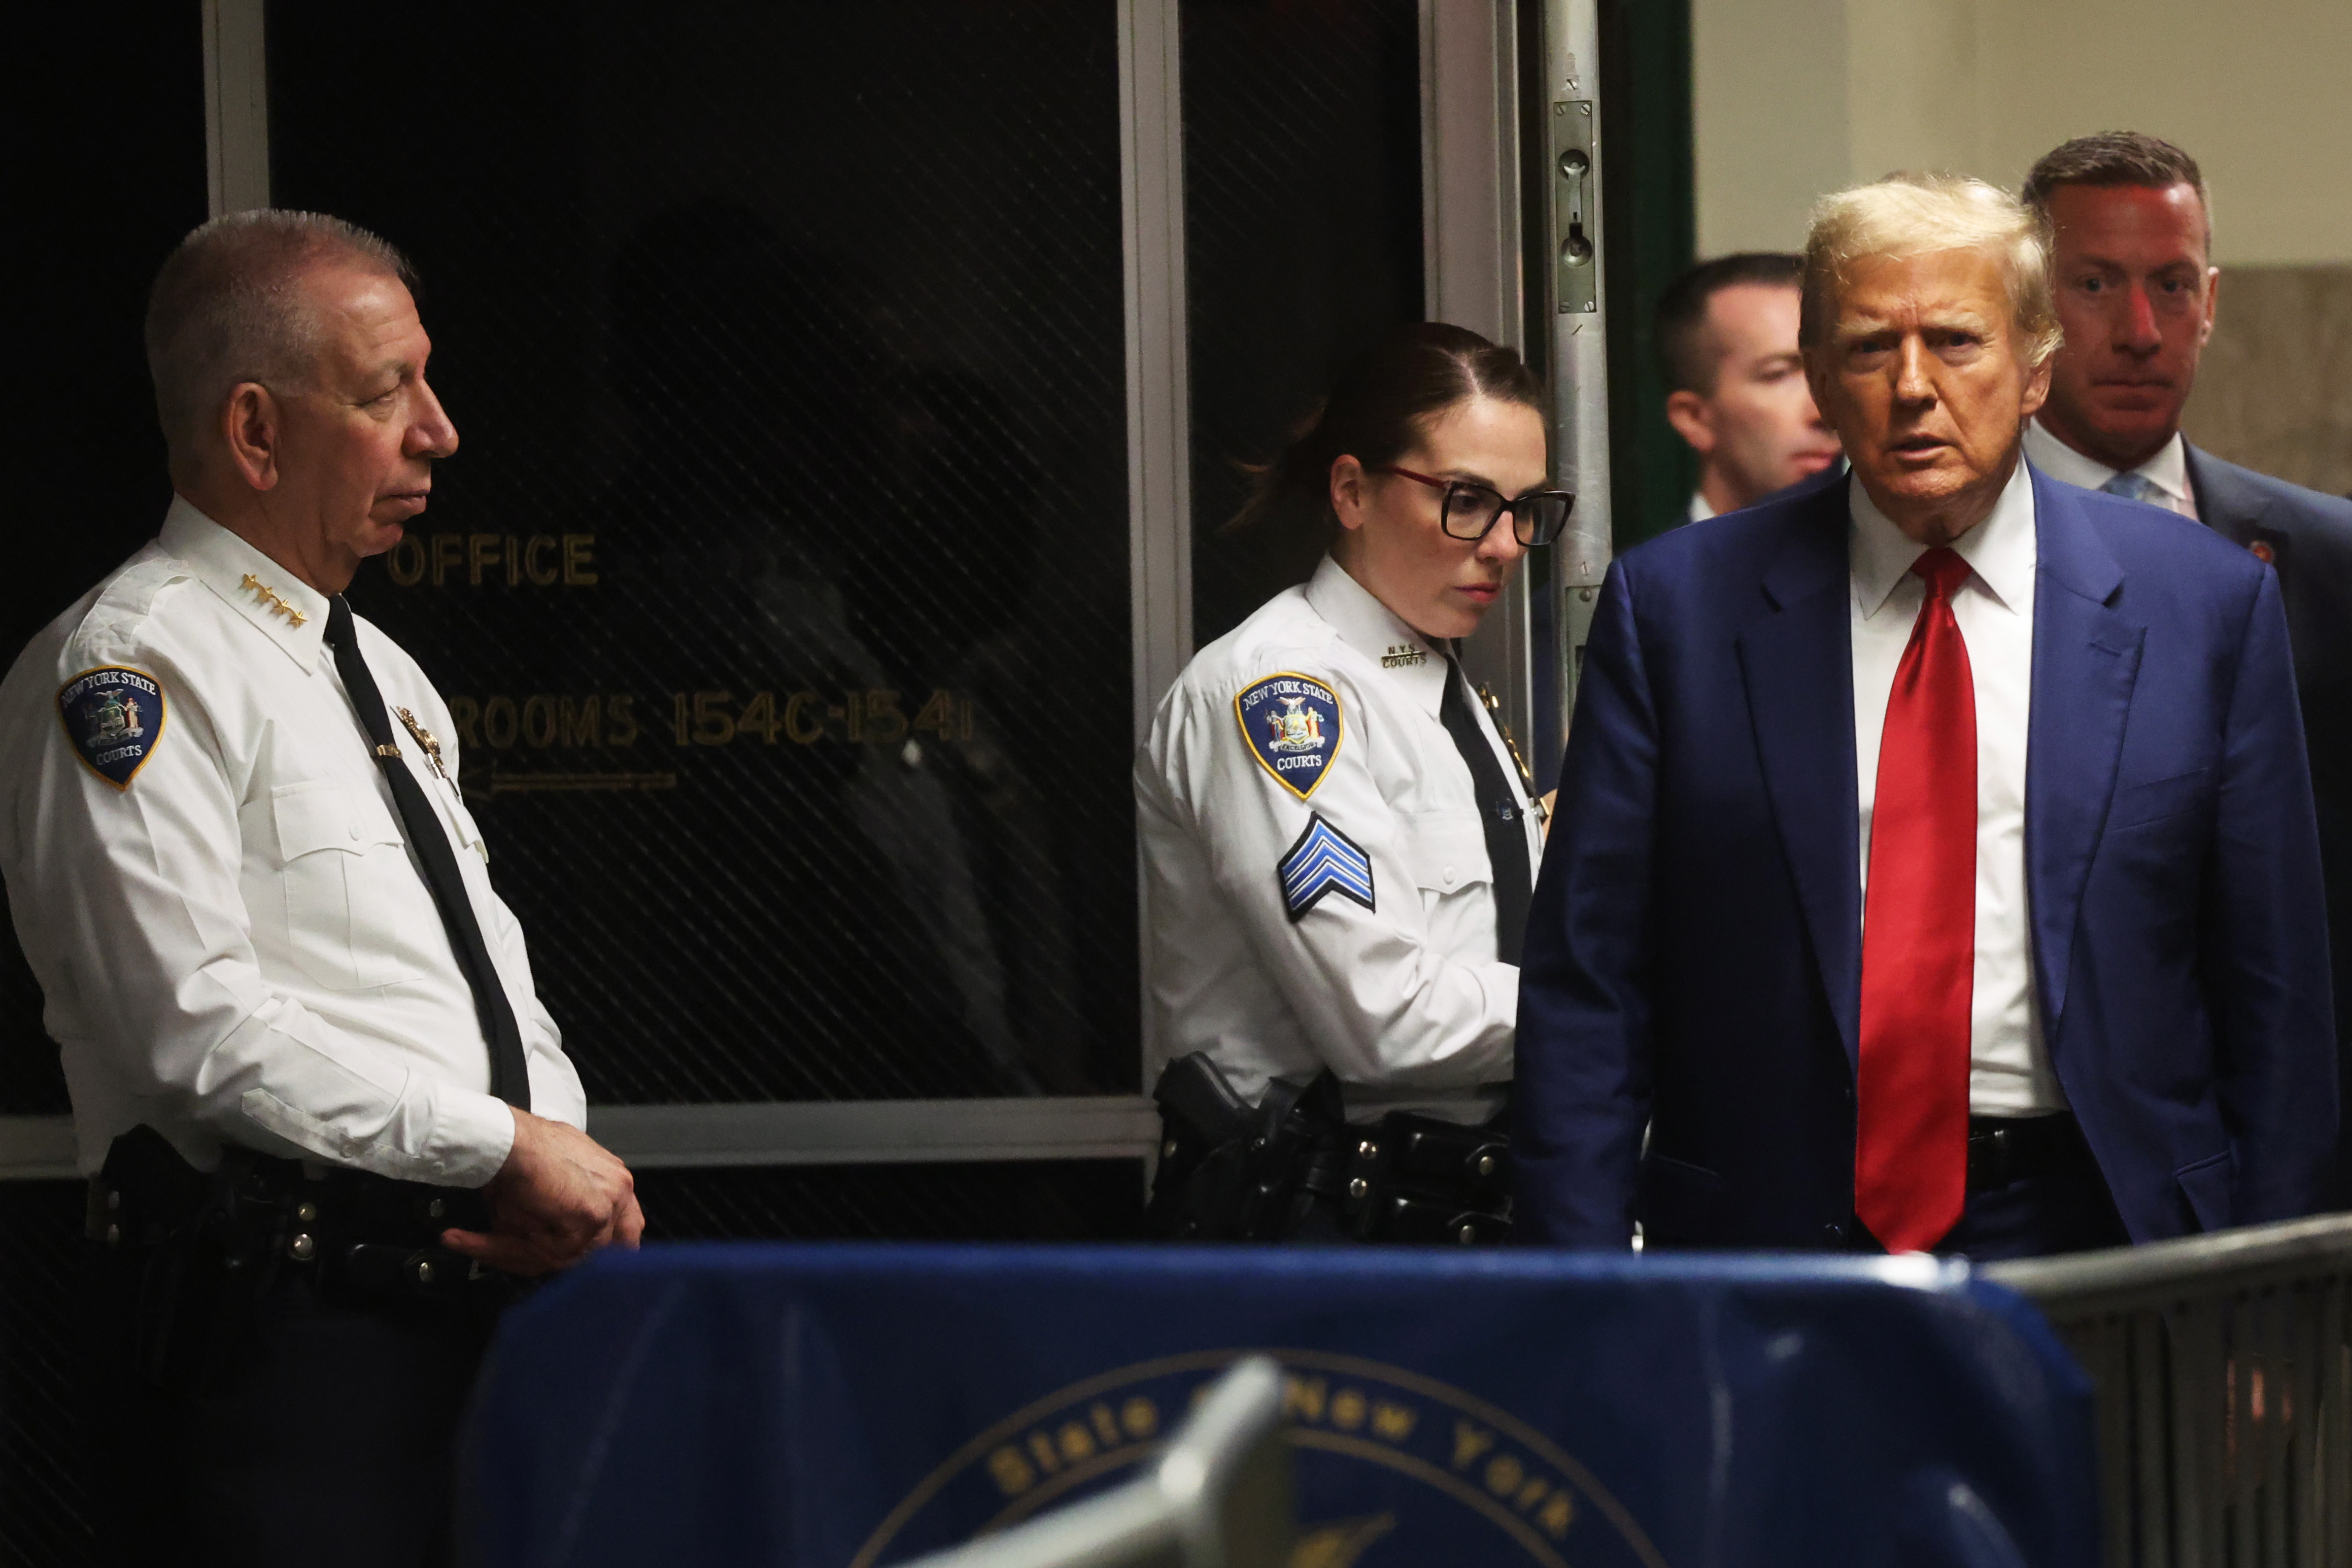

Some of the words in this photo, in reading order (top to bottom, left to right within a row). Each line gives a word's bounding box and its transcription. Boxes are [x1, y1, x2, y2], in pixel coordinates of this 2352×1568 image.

[387, 533, 599, 587] OFFICE
[1382, 655, 1426, 668] COURTS
[61, 680, 85, 708] NEW
[84, 671, 120, 689] YORK
[121, 672, 156, 696] STATE
[1243, 686, 1269, 711] NEW
[1269, 680, 1302, 696] YORK
[1303, 683, 1334, 704] STATE
[450, 695, 637, 748] ROOMS
[96, 744, 143, 765] COURTS
[1277, 755, 1322, 771] COURTS
[988, 1394, 1162, 1496] State
[1281, 1374, 1419, 1444] New
[1451, 1417, 1574, 1542] York
